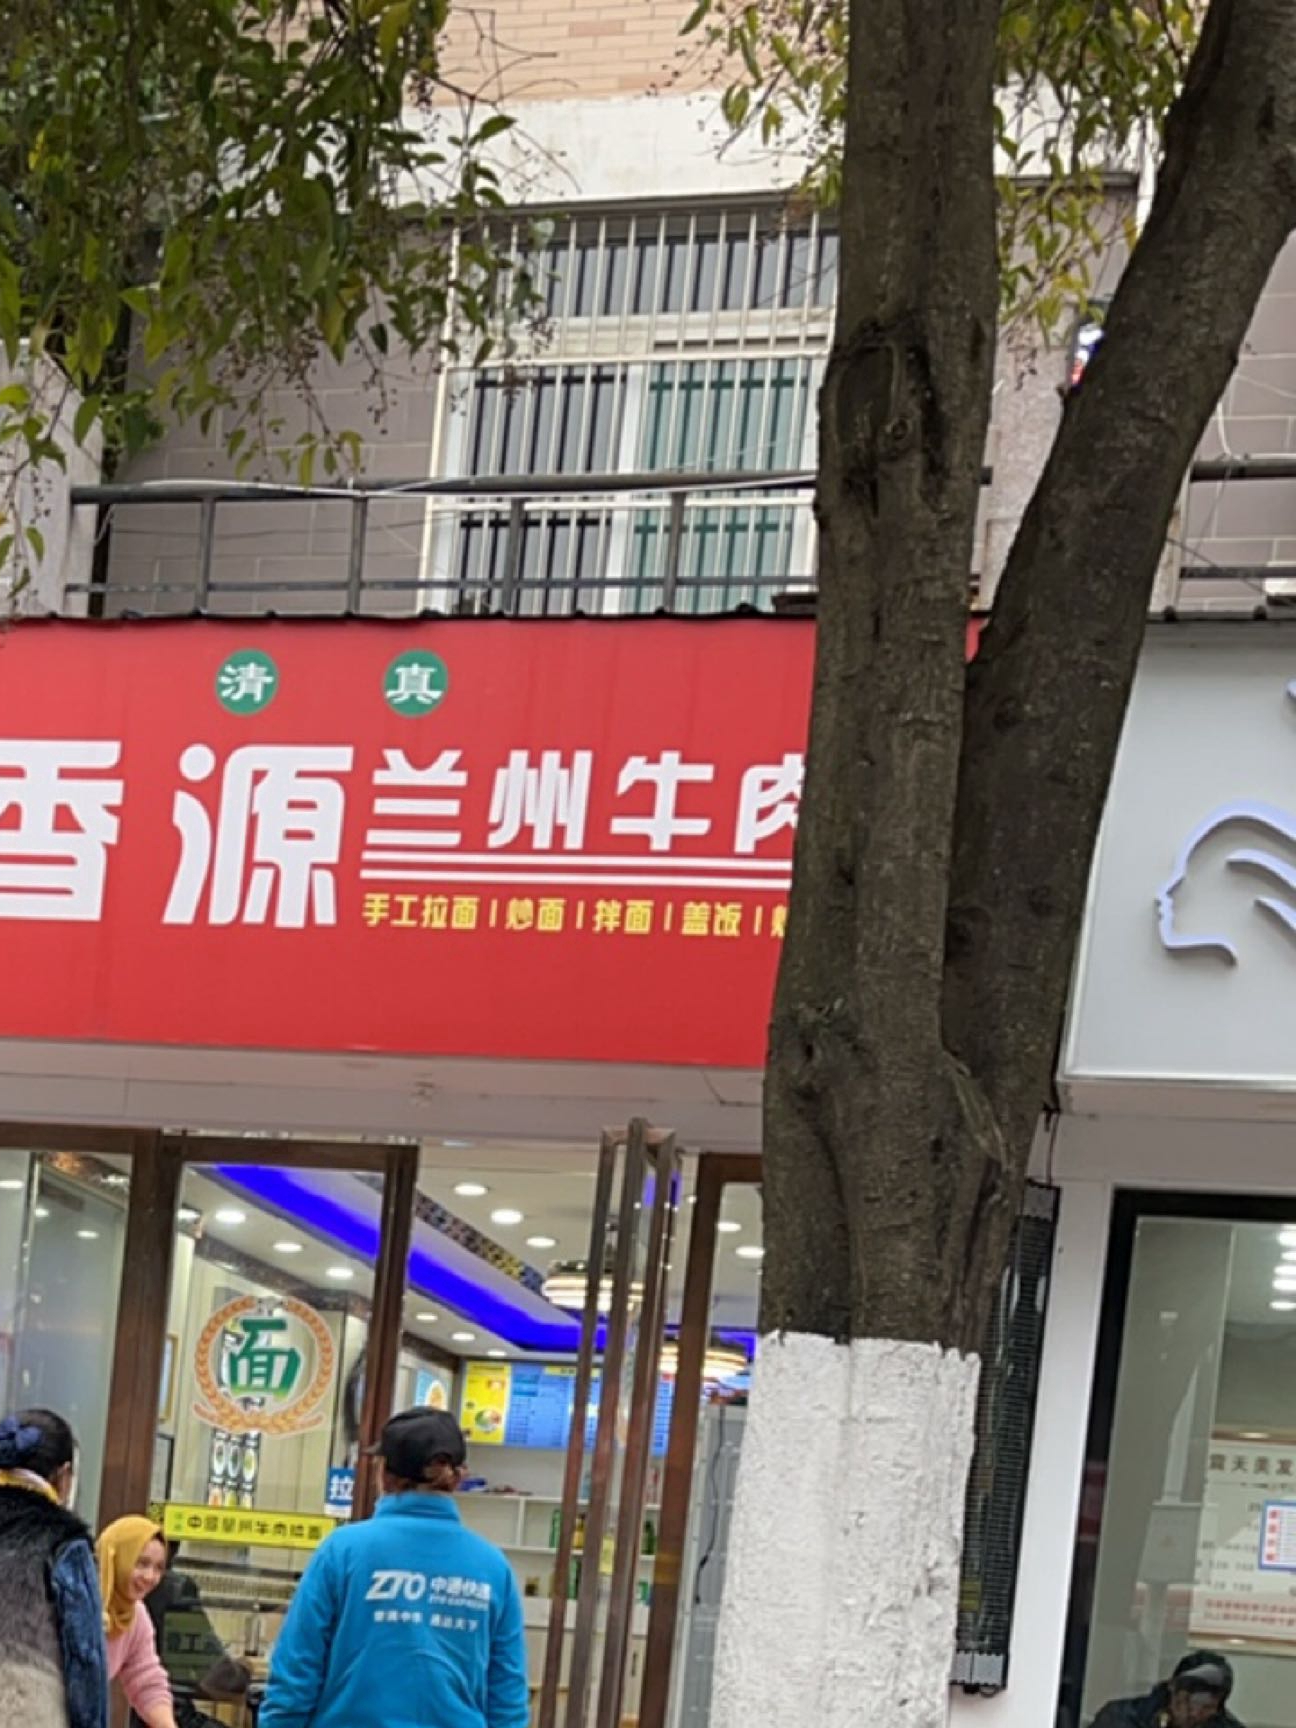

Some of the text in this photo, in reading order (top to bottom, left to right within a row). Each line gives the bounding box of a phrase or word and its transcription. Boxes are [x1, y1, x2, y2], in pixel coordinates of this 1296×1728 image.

[219, 662, 443, 704] 清真
[365, 749, 806, 854] 兰州牛肉
[362, 893, 479, 929] 手工拉面
[506, 898, 566, 932] 炒面
[593, 900, 655, 935] 拌面
[681, 902, 743, 937] 盖饭
[229, 1318, 301, 1400] 面
[365, 1568, 426, 1600] ZTO
